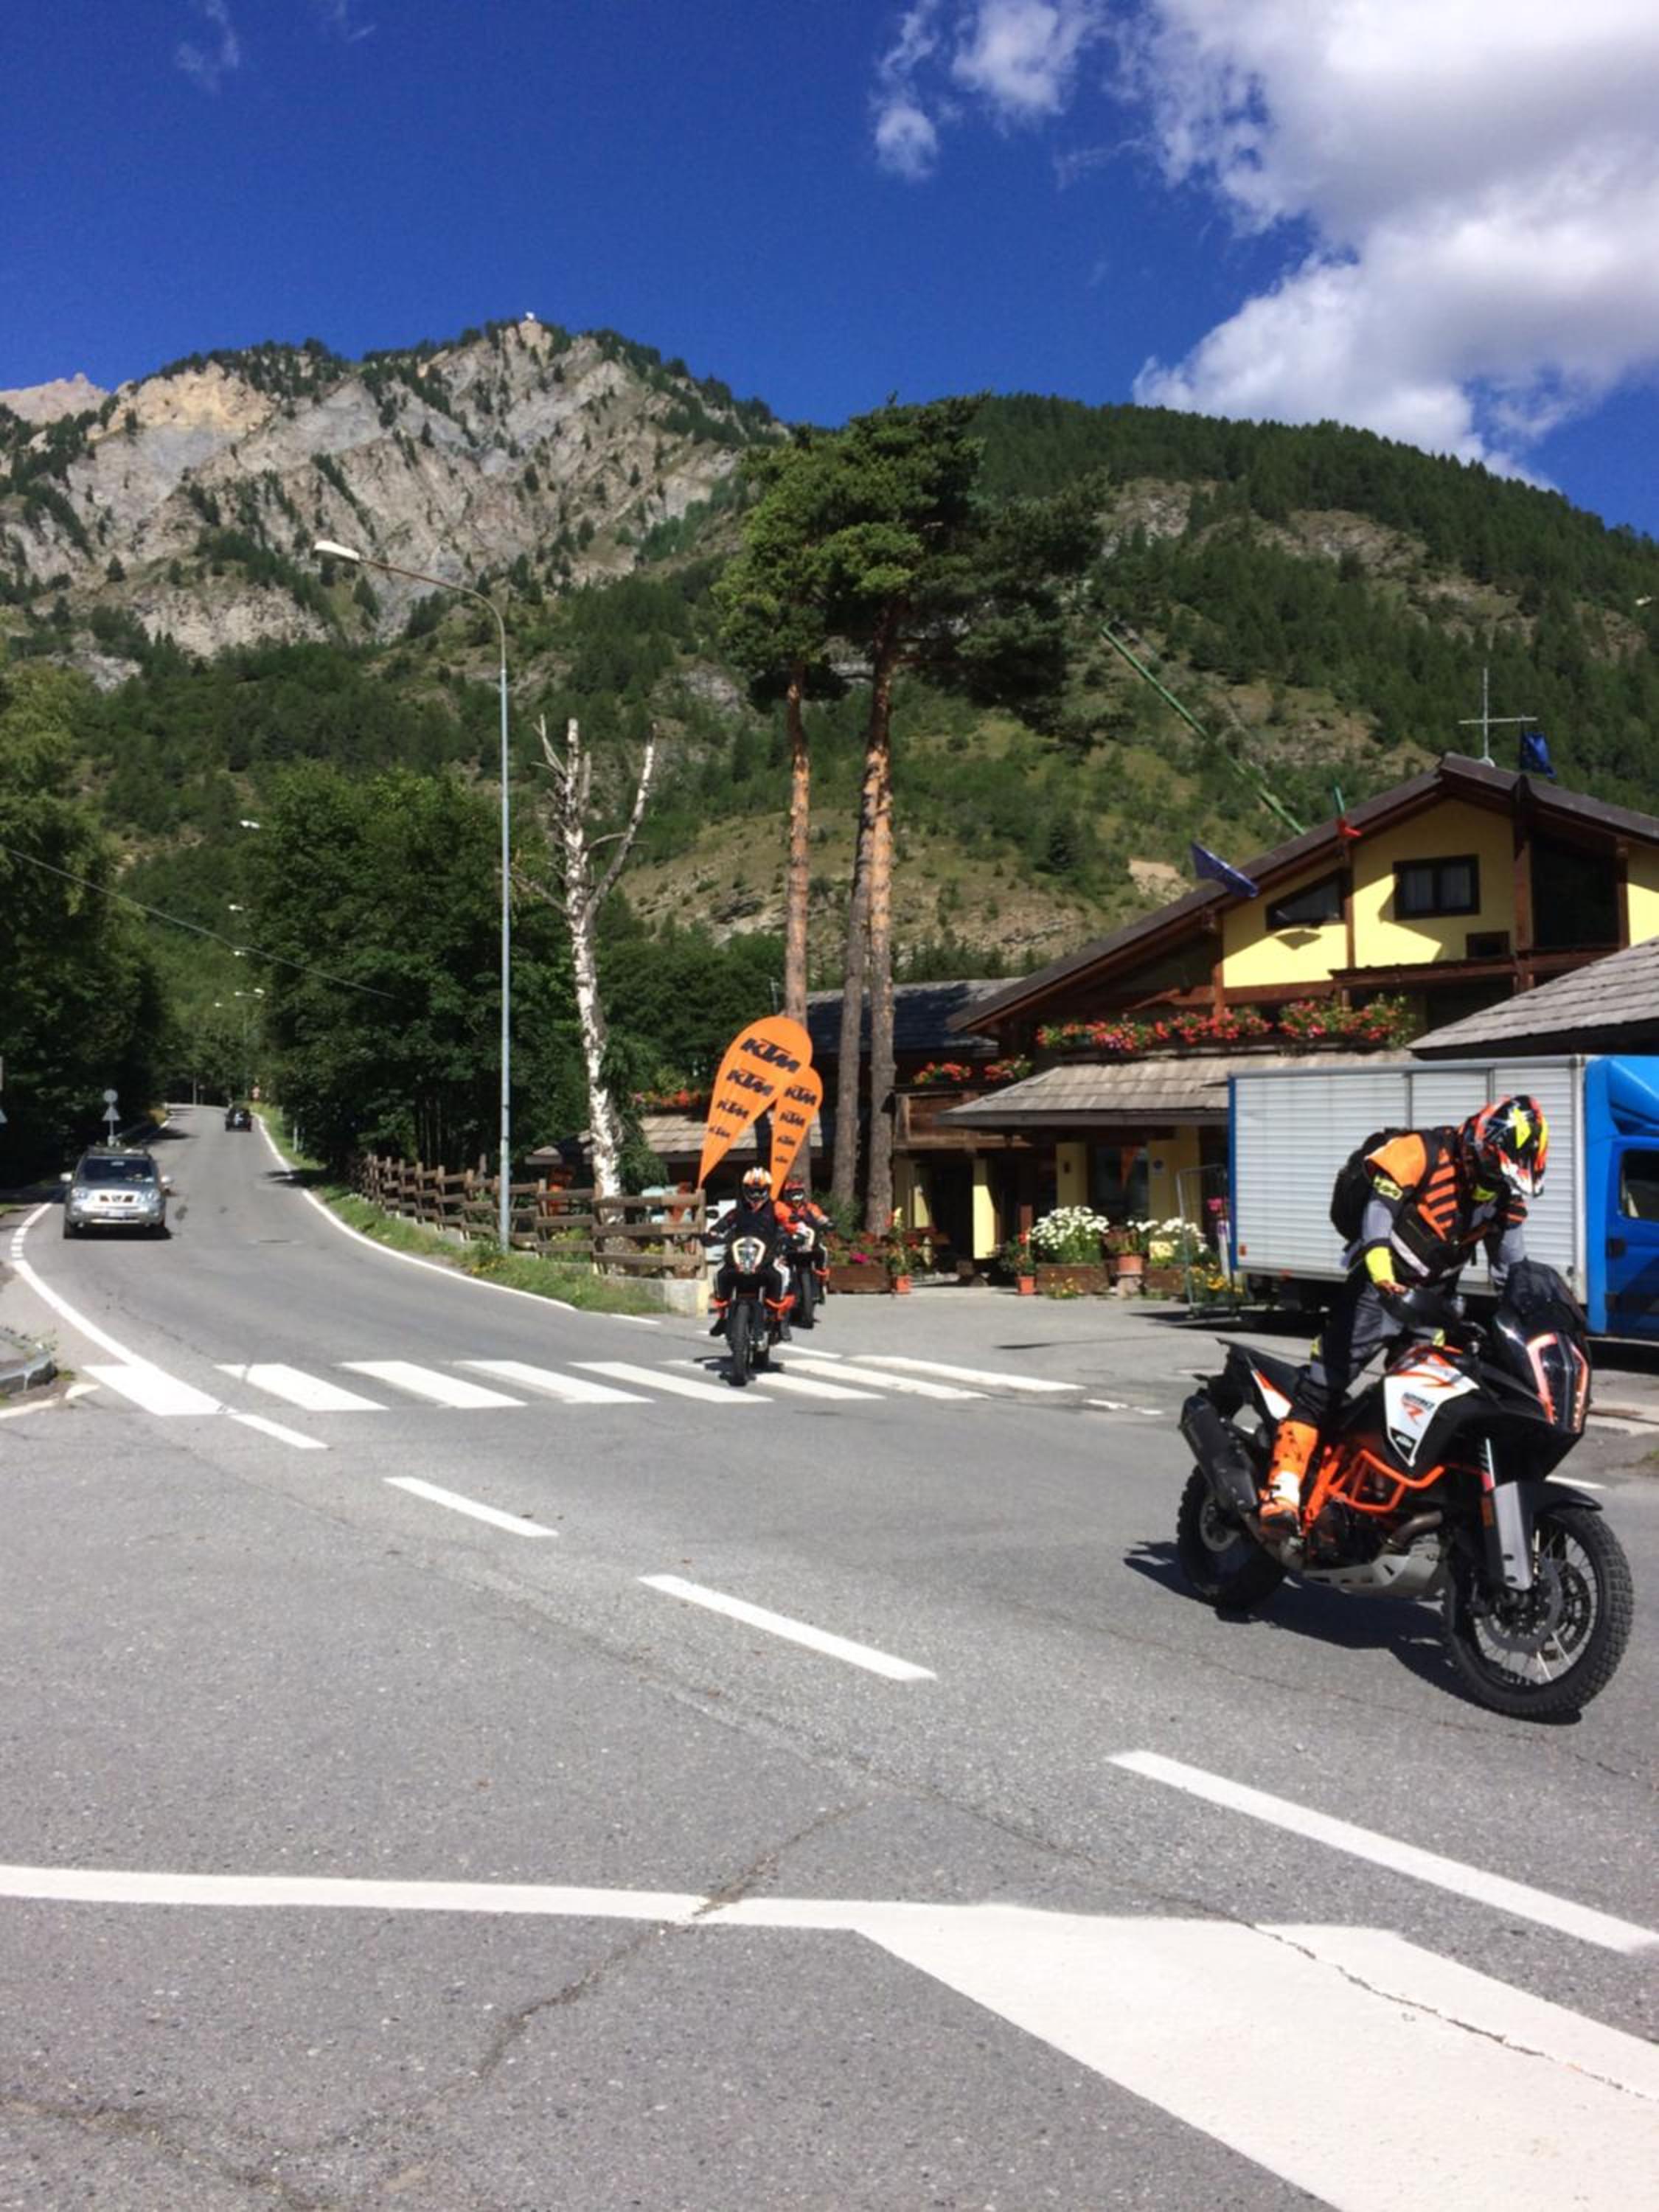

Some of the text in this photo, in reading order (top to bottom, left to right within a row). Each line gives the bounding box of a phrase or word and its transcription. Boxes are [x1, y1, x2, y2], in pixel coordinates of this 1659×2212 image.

[740, 1037, 801, 1074] KTM
[726, 1068, 774, 1097] KTM
[784, 1085, 817, 1106] KTM
[717, 1099, 749, 1119] KTM
